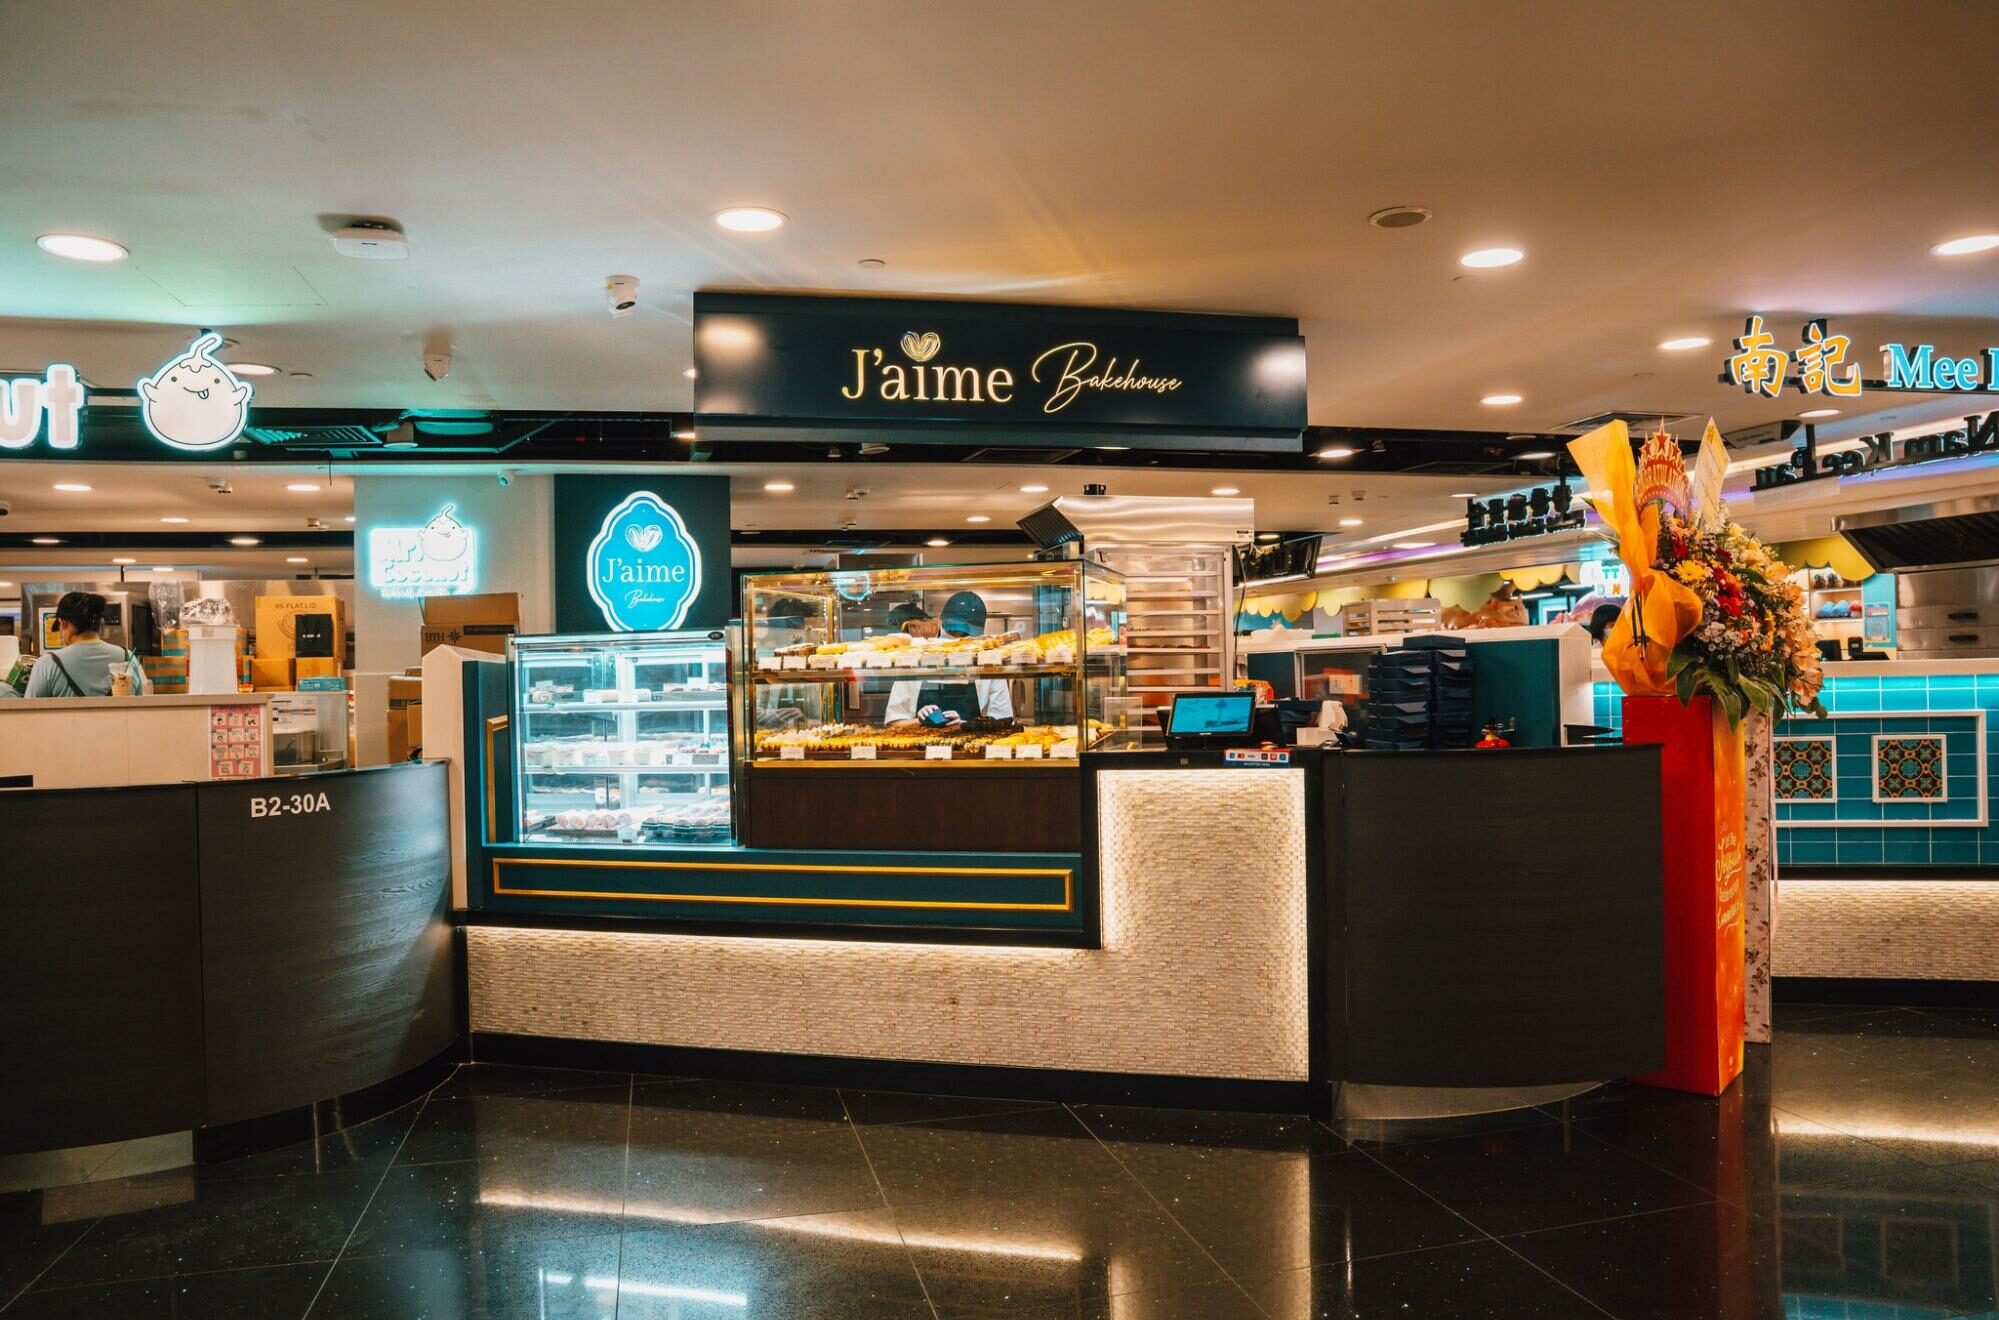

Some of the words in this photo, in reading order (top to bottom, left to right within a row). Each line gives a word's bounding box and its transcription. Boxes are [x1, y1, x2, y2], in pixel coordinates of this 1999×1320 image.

[842, 348, 1014, 403] J'aime
[1032, 342, 1182, 413] Bakehouse
[1731, 315, 1862, 397] 南記
[1887, 343, 1979, 391] Mee
[602, 558, 685, 583] J'aime
[250, 792, 331, 819] B2-30A
